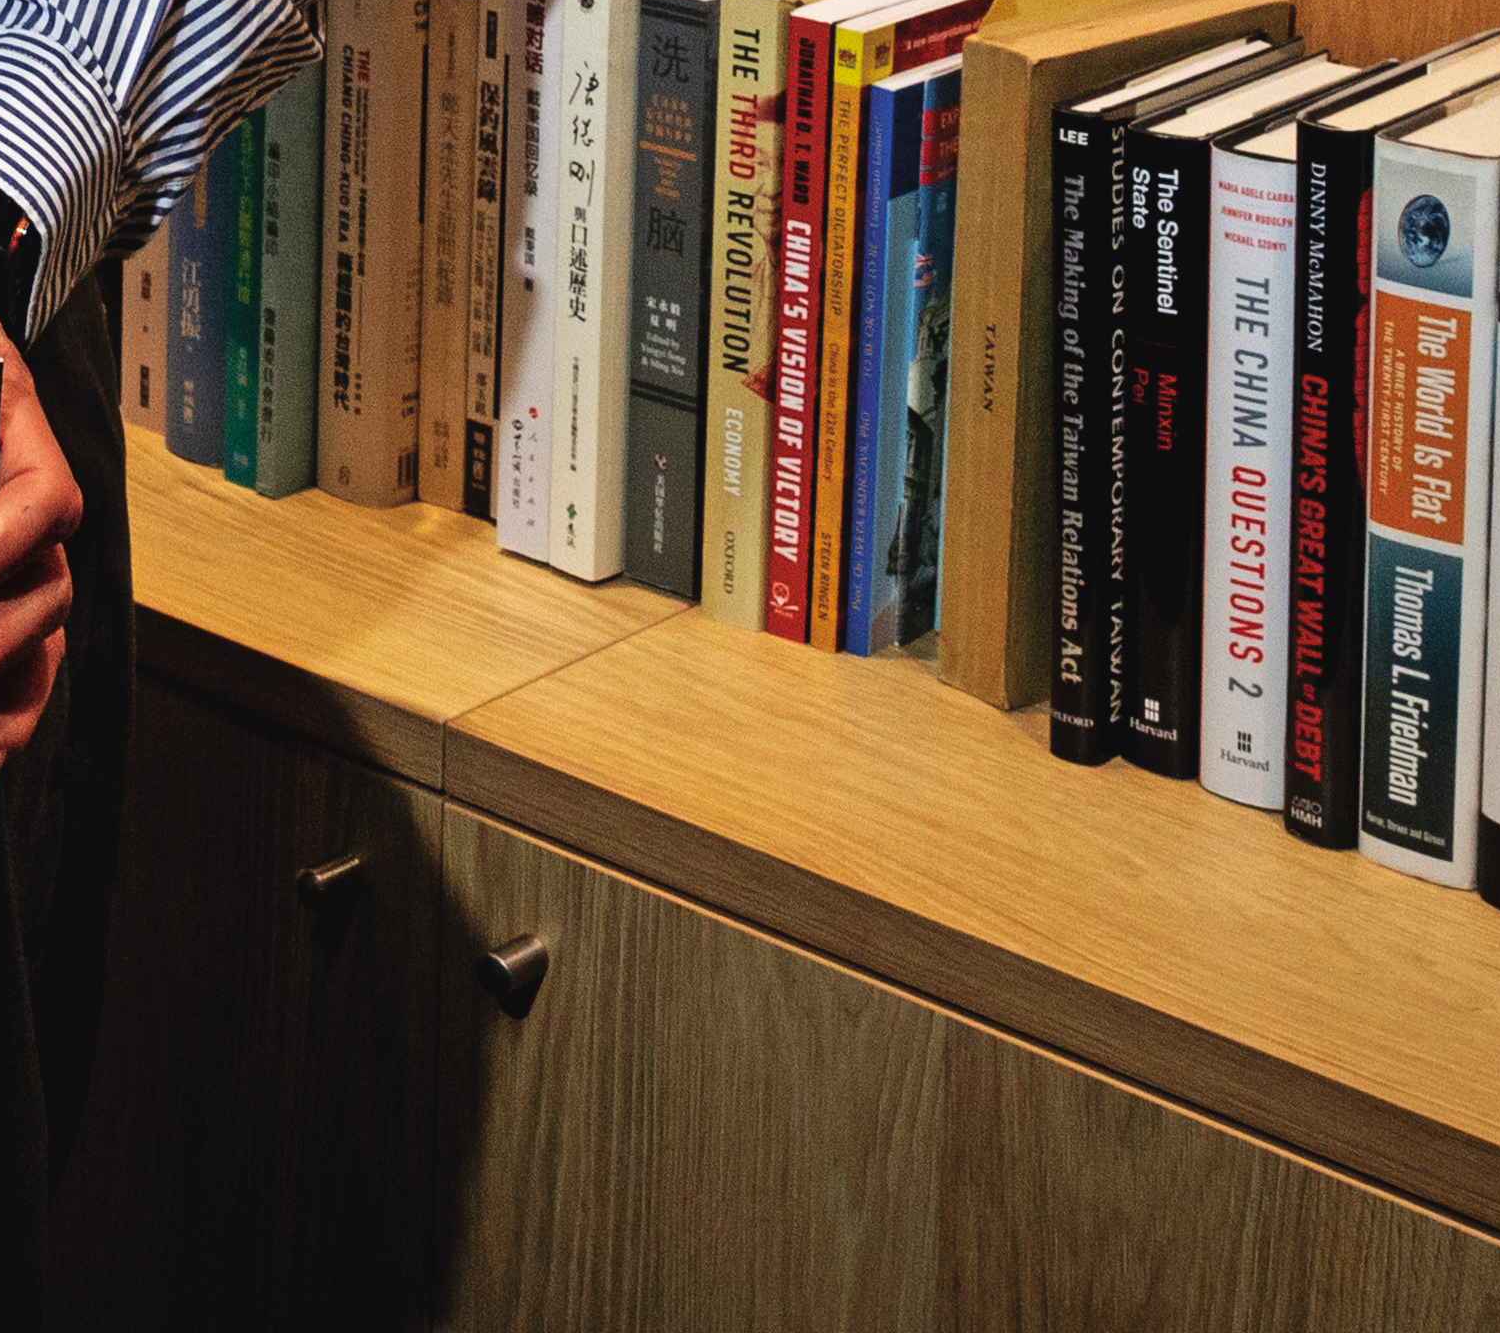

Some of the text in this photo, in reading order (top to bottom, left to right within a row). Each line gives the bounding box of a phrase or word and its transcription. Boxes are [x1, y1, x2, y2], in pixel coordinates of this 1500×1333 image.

[357, 49, 371, 82] THE
[652, 35, 690, 83] 洗
[337, 44, 354, 243] CHIANG CHING-KUO ERA
[1059, 128, 1089, 146] LEE
[722, 29, 760, 374] THE THIRD REVOLUTION
[830, 99, 851, 317] THE PERFECT DICTATORSHIP
[1132, 166, 1150, 230] State
[1157, 169, 1179, 316] The Sentinel
[1307, 161, 1327, 353] DINNY McMAHON
[773, 219, 812, 563] CHINA'S VISION OF VICTORY
[980, 324, 996, 413] TAIWAN
[1133, 367, 1149, 404] Pei
[1157, 372, 1178, 450] Minxin
[724, 407, 744, 497] ECONOMY
[1058, 174, 1085, 685] The Making of the Taiwan Relations Act
[1110, 125, 1125, 724] STUDIES ON CONTEMPORARY TAIWAN
[1299, 373, 1329, 494] CHINA'S
[1411, 314, 1457, 525] The World Is Flat
[1227, 277, 1270, 699] THE CHINA QUESTIONS 2
[725, 531, 735, 595] OXFORD
[817, 532, 833, 620] STEIN RINGEN
[1298, 497, 1326, 595] GREAT
[1296, 600, 1324, 676] WALL
[1130, 716, 1177, 742] Harvard
[1387, 564, 1434, 808] Thomas L. Friedman
[1220, 748, 1270, 773] Harvard
[1294, 700, 1323, 782] DEBT
[1291, 806, 1322, 828] HMH
